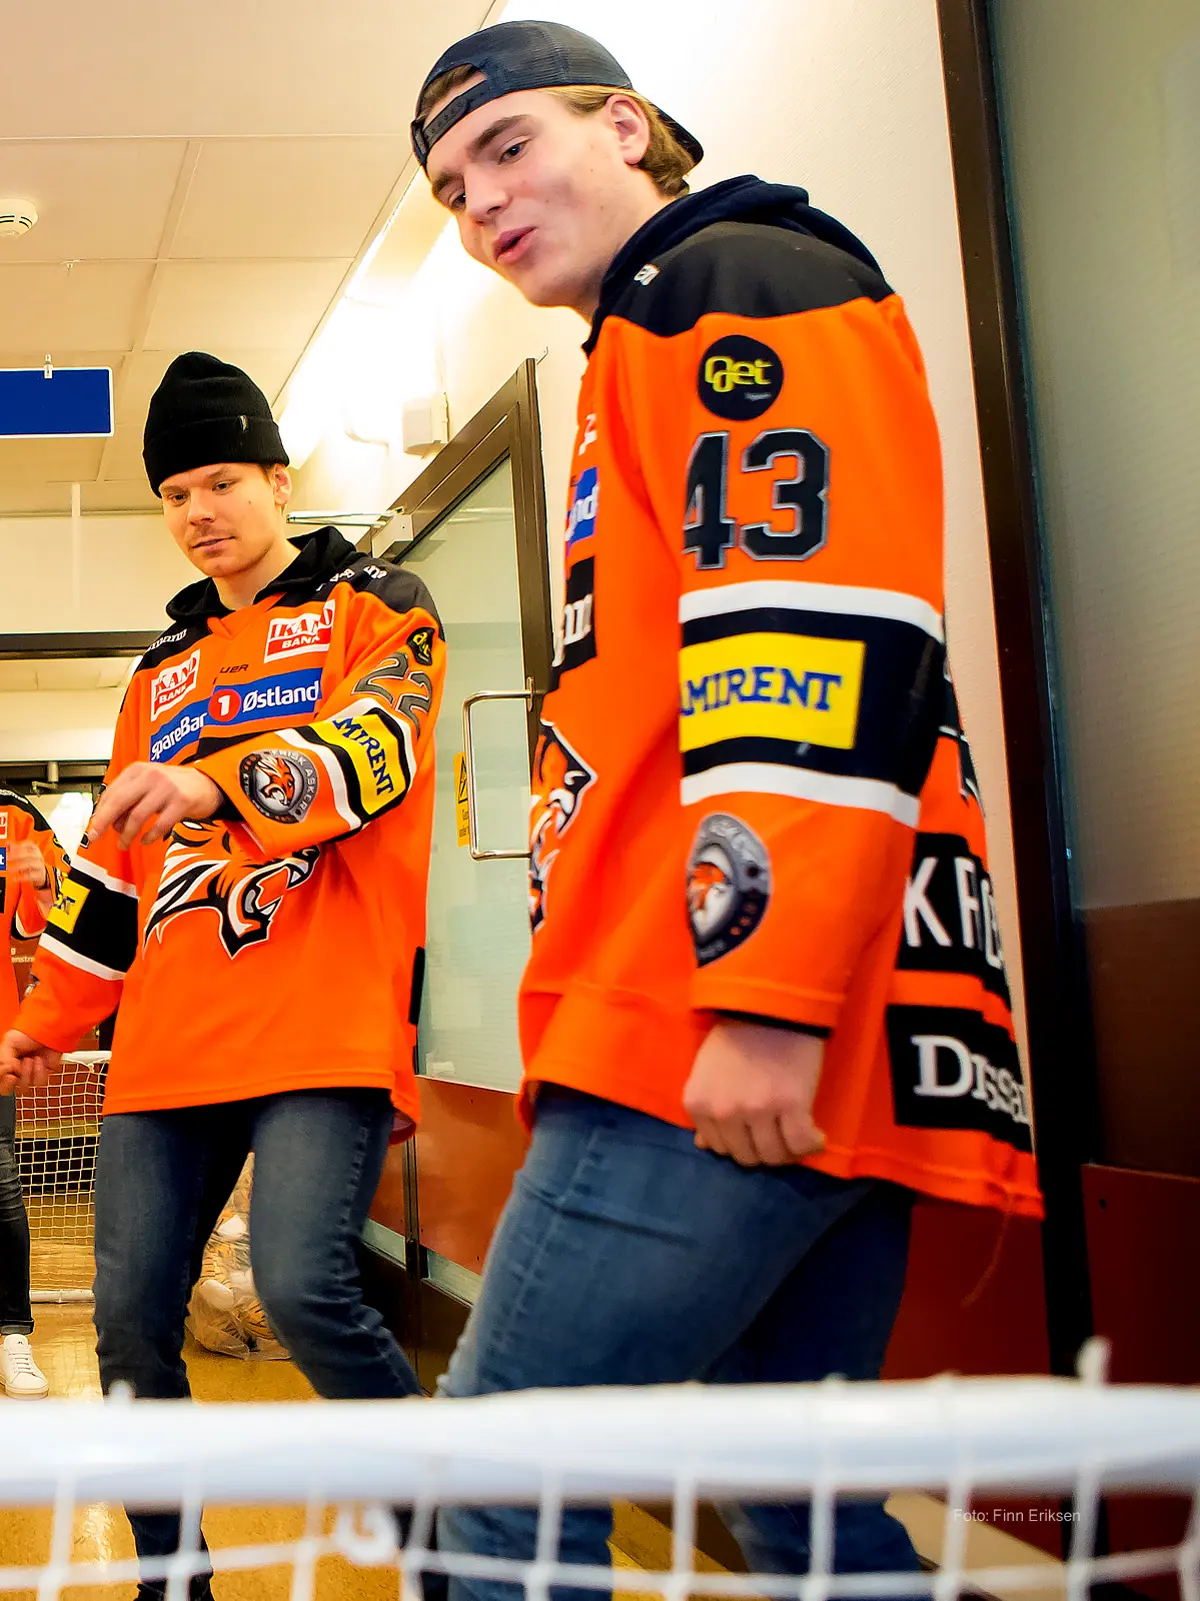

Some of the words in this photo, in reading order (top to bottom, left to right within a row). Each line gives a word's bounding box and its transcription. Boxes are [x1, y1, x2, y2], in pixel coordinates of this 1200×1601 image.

[682, 427, 831, 570] 43
[242, 680, 319, 713] Østland
[350, 652, 433, 740] 22
[332, 717, 394, 796] MIRENT
